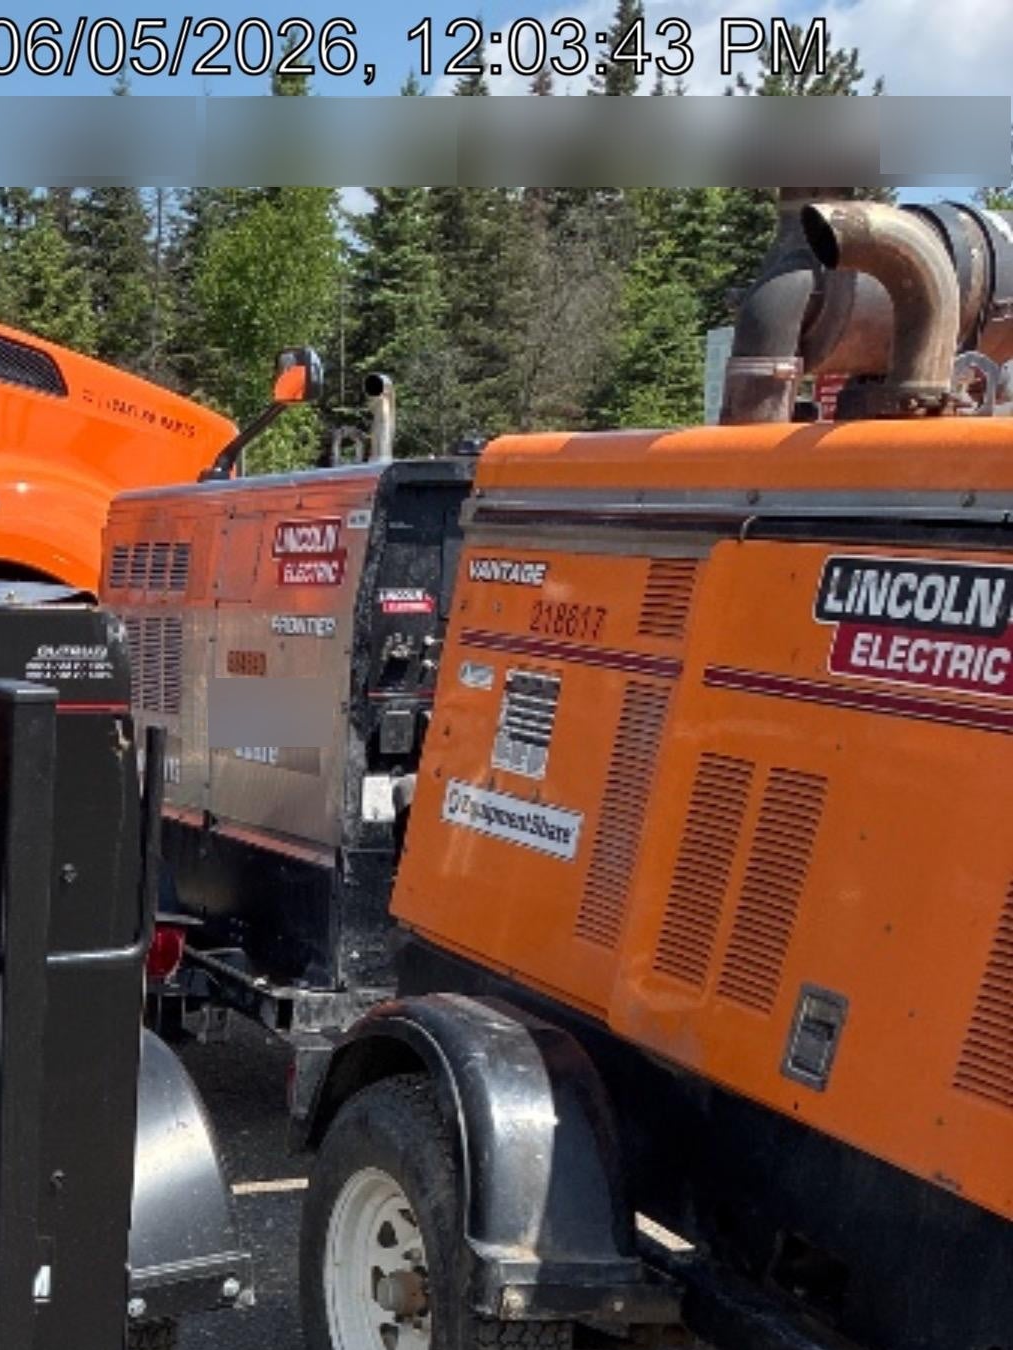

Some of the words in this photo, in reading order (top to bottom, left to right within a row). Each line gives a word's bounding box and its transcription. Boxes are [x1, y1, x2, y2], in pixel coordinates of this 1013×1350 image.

[274, 523, 338, 553] LINCOLN
[283, 562, 338, 583] ELECTRIC
[469, 560, 547, 586] VANTAGE
[824, 566, 1006, 628] LINCOLN
[272, 615, 336, 638] FRONTIER
[850, 631, 1012, 685] ELECTRIC
